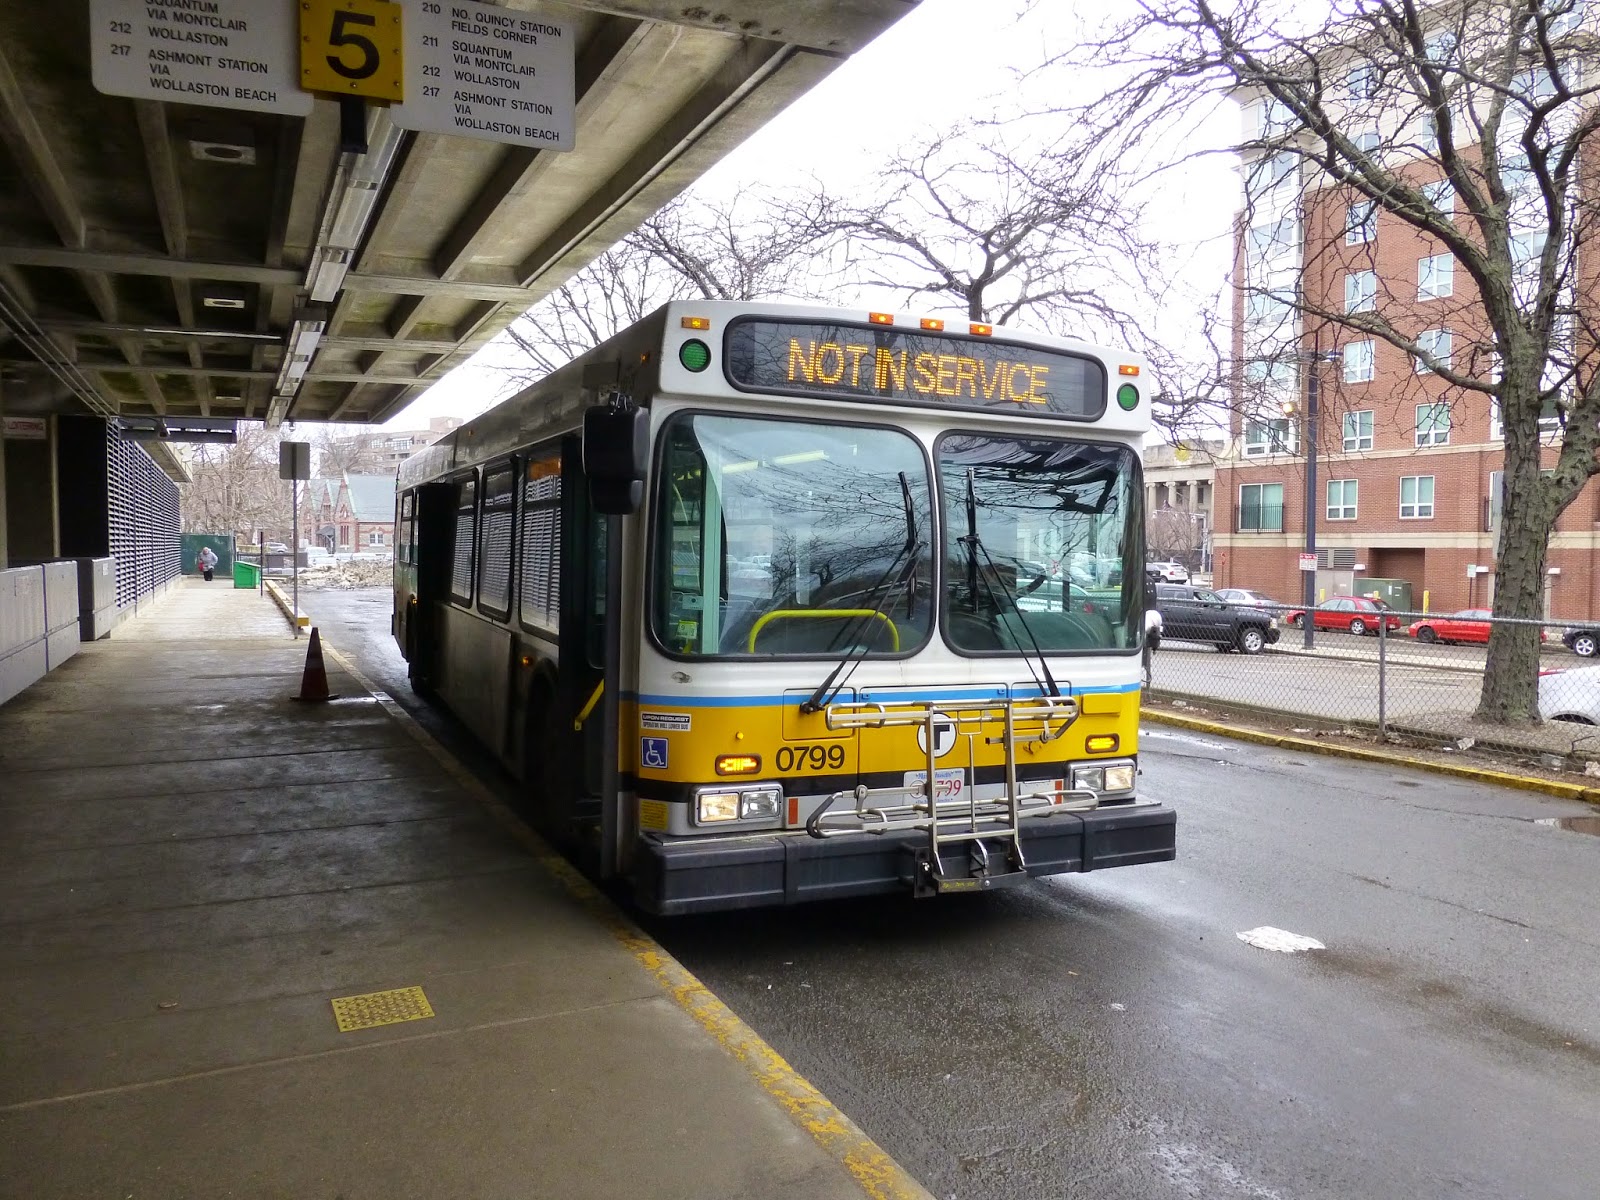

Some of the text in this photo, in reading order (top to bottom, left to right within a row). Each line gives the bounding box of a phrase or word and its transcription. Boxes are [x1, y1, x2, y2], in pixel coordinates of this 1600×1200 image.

[146, 7, 247, 31] VIA MONTCLAIR
[422, 3, 561, 37] 210 NO. QUINCY STATION
[110, 21, 229, 47] 212 WOLLASTON
[325, 9, 380, 79] 5
[452, 21, 537, 45] FIELDS CORNER
[111, 44, 268, 74] 217 ASHMONT STATION
[422, 36, 512, 60] 211 SQUANTUM
[149, 63, 171, 75] VIA
[422, 65, 520, 90] 212 WOLLASTON
[453, 54, 536, 77] VIA MONTCLAIR
[150, 77, 277, 102] WOLLASTON BEACH
[423, 86, 552, 115] 217 ASHMONT STATION
[455, 104, 471, 115] VIA
[455, 117, 559, 141] WOLLASTON BEACH
[788, 339, 1048, 404] NOT IN SERVICE
[776, 744, 845, 772] 0799
